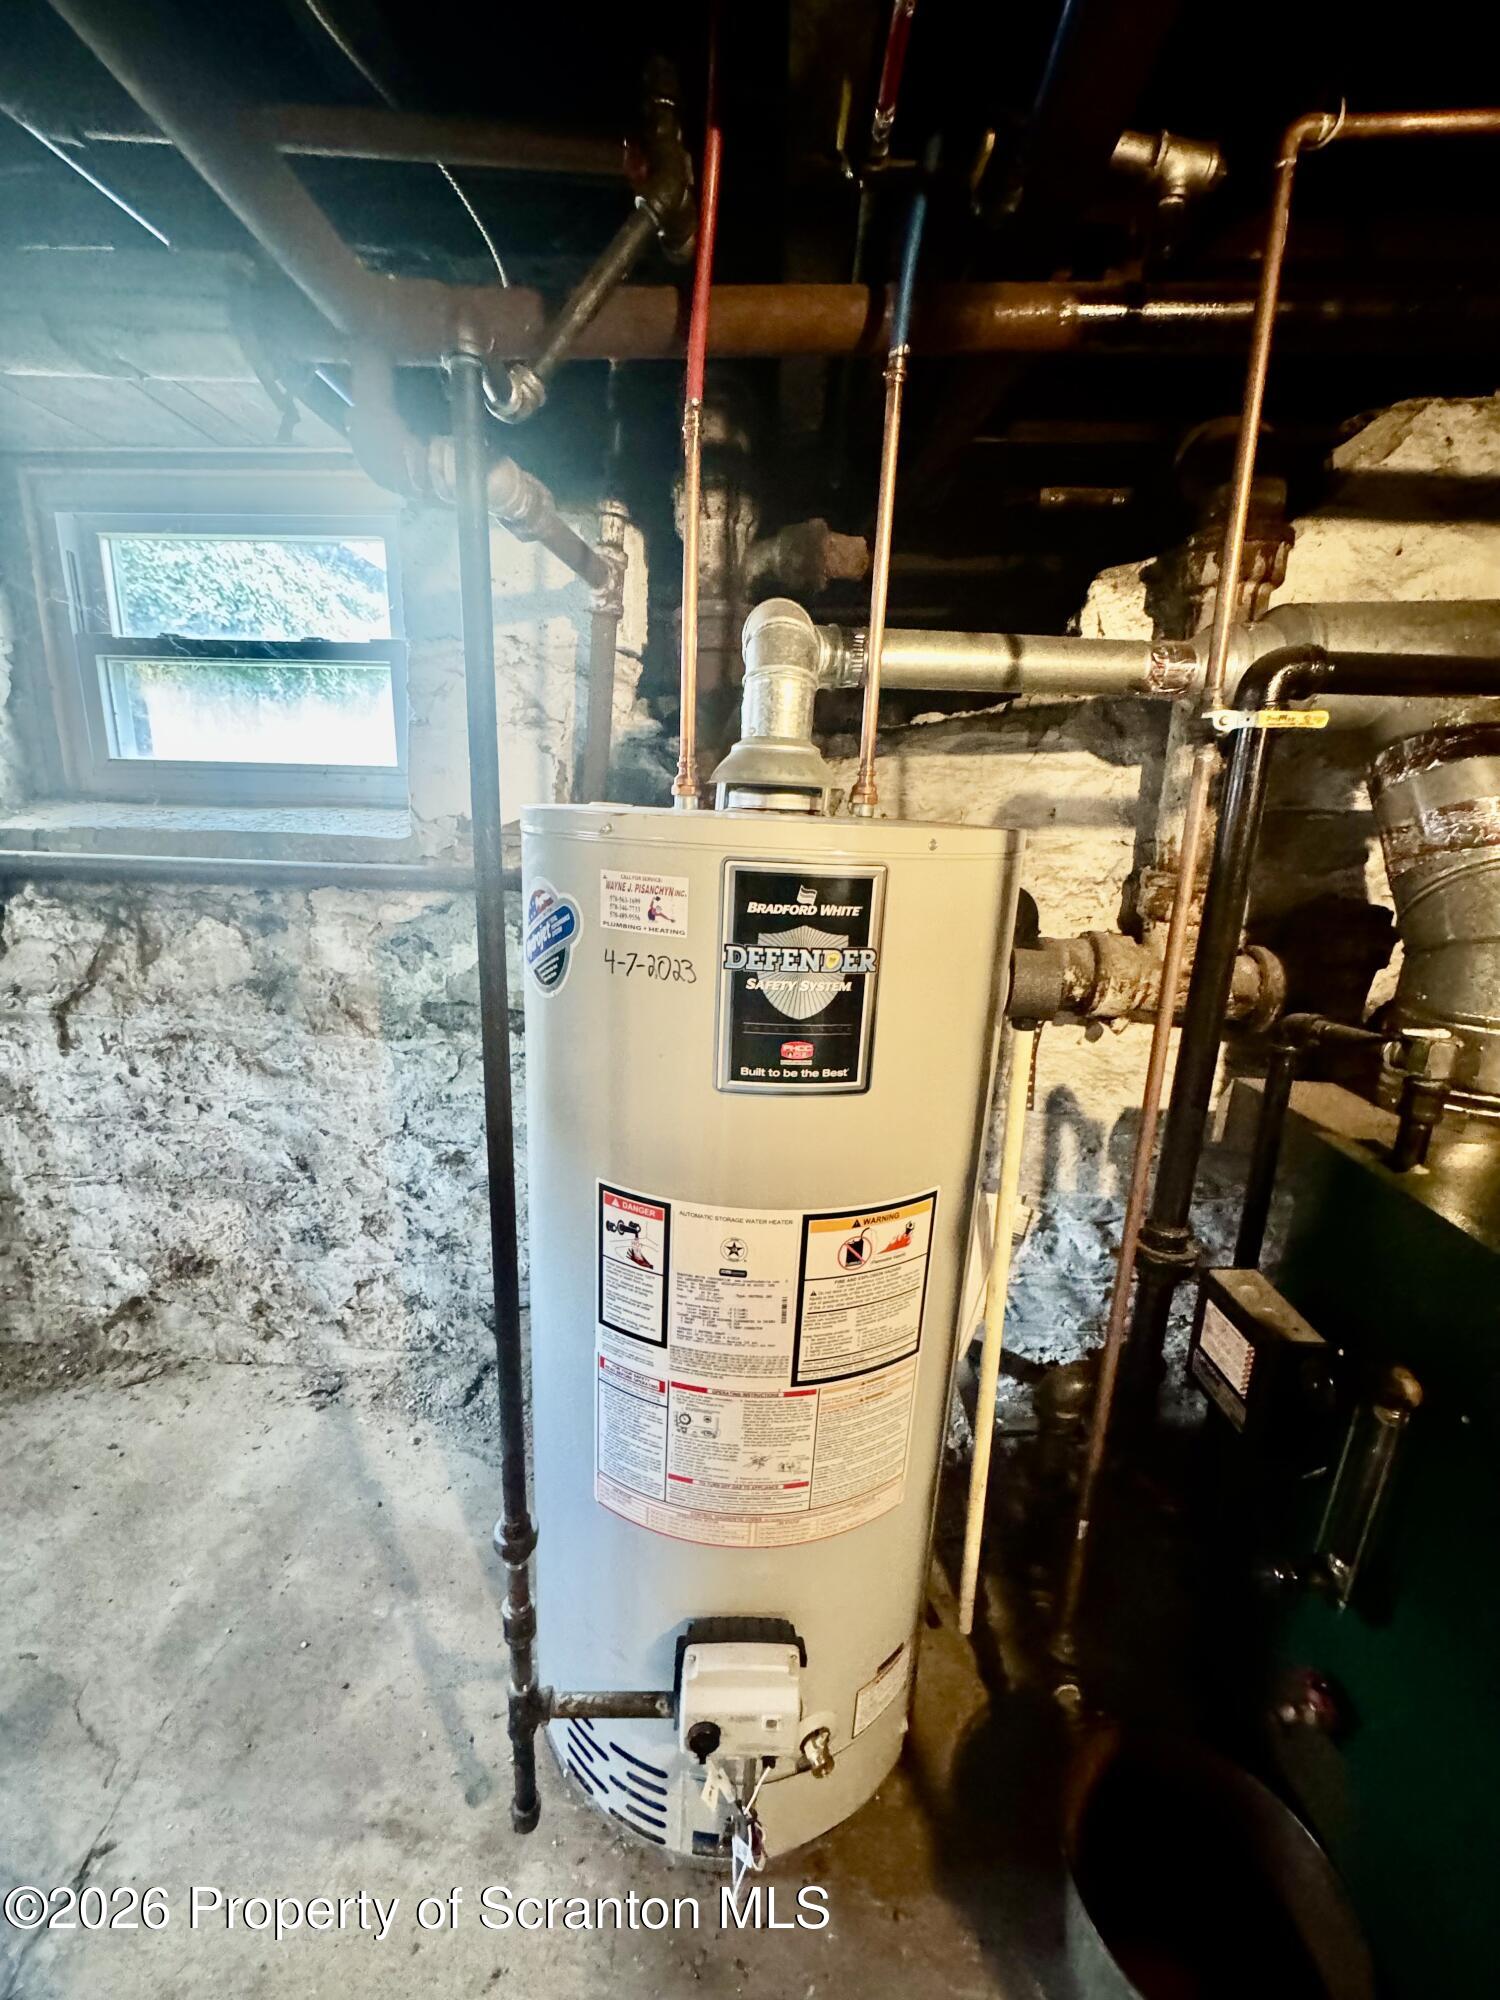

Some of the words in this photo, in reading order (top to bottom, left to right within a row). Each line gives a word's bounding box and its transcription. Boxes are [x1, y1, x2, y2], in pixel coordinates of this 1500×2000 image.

[605, 880, 626, 892] WAYNE
[627, 883, 633, 893] J.
[634, 884, 675, 897] PISANCHYN
[674, 890, 687, 898] INC.
[747, 902, 818, 916] BRADFORD
[820, 905, 862, 917] WHITE
[602, 920, 642, 931] PLUMBING
[649, 927, 686, 936] HEATING
[604, 948, 697, 984] 4-7-2023
[724, 944, 878, 973] DEFENDER
[745, 978, 797, 991] SAFETY
[799, 980, 852, 992] SYSTEM
[740, 1067, 765, 1077] Built
[768, 1069, 781, 1078] to
[783, 1068, 798, 1078] be
[800, 1068, 820, 1078] the
[822, 1068, 848, 1078] Best
[622, 1201, 656, 1217] DANGER
[679, 1211, 713, 1221] AUTOMATIC
[714, 1215, 744, 1224] STORAGE
[862, 1212, 900, 1226] WARNING
